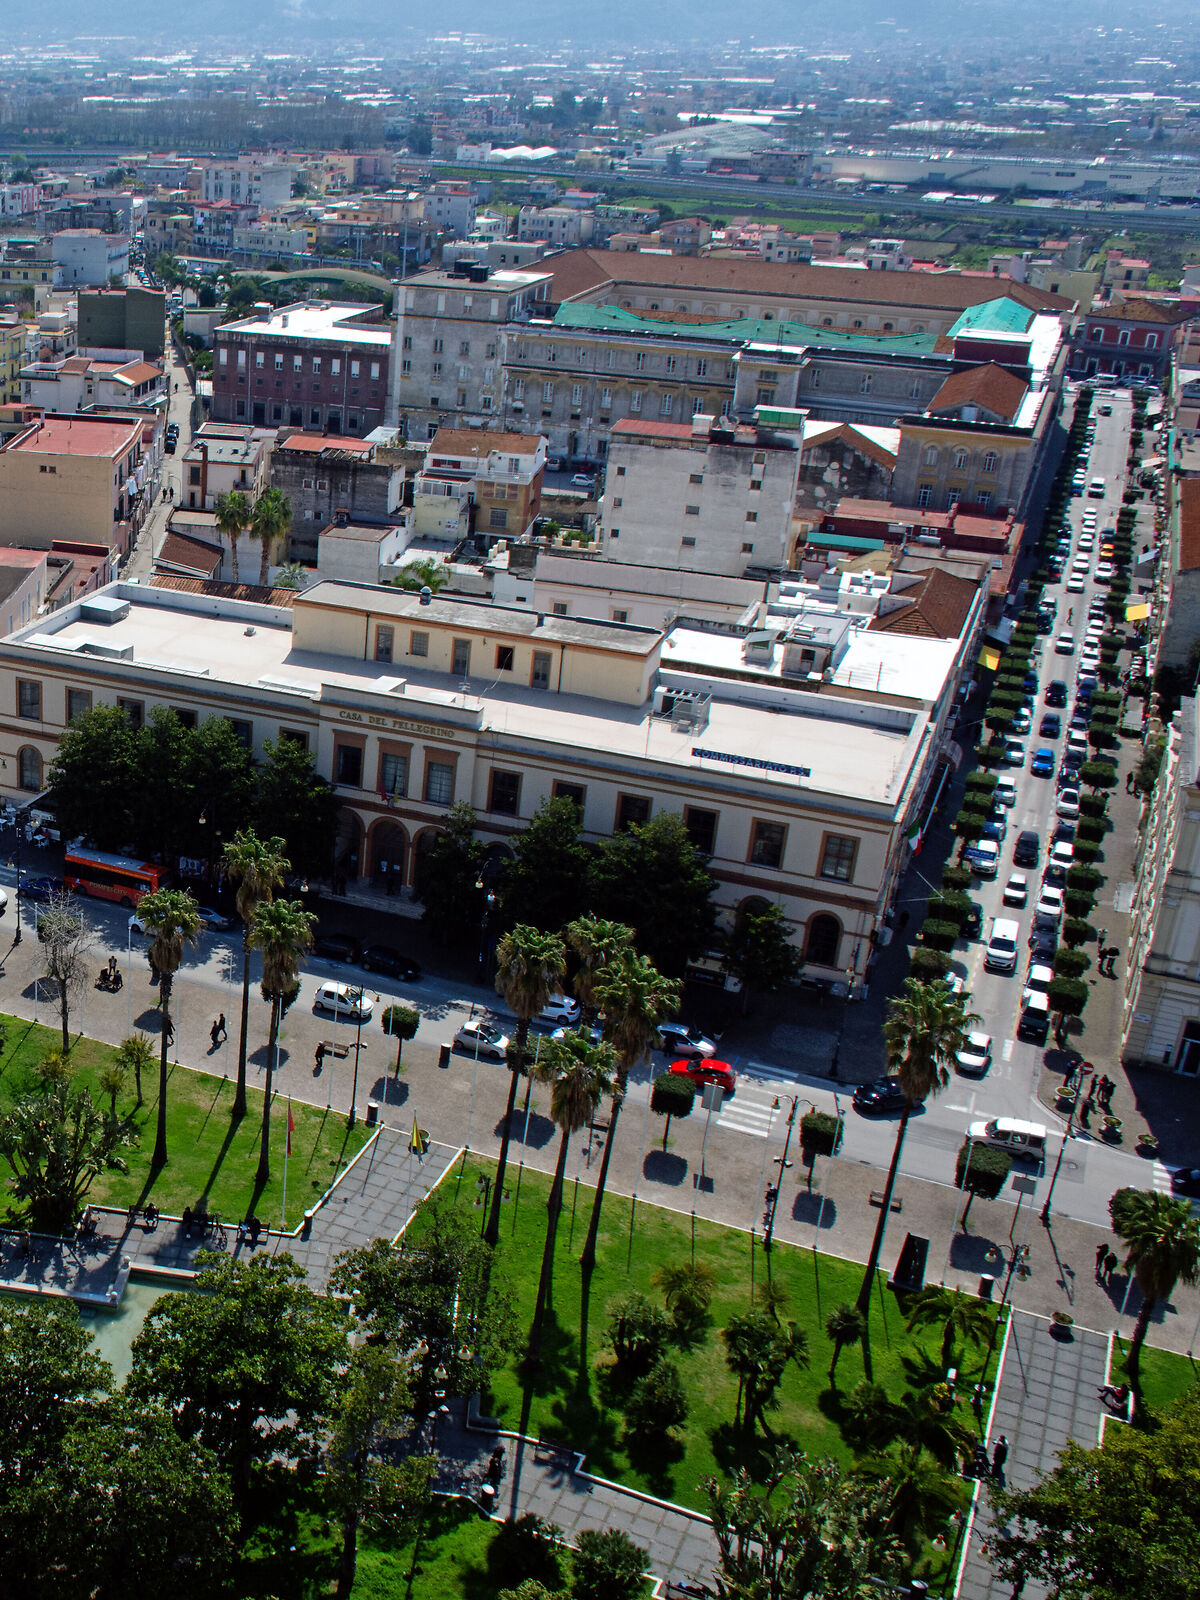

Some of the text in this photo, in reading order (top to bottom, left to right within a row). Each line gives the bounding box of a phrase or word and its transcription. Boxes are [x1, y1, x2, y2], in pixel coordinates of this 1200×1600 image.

[339, 710, 456, 738] CASA DEL PELLEGRINO
[694, 749, 787, 773] COMMISSARIATO
